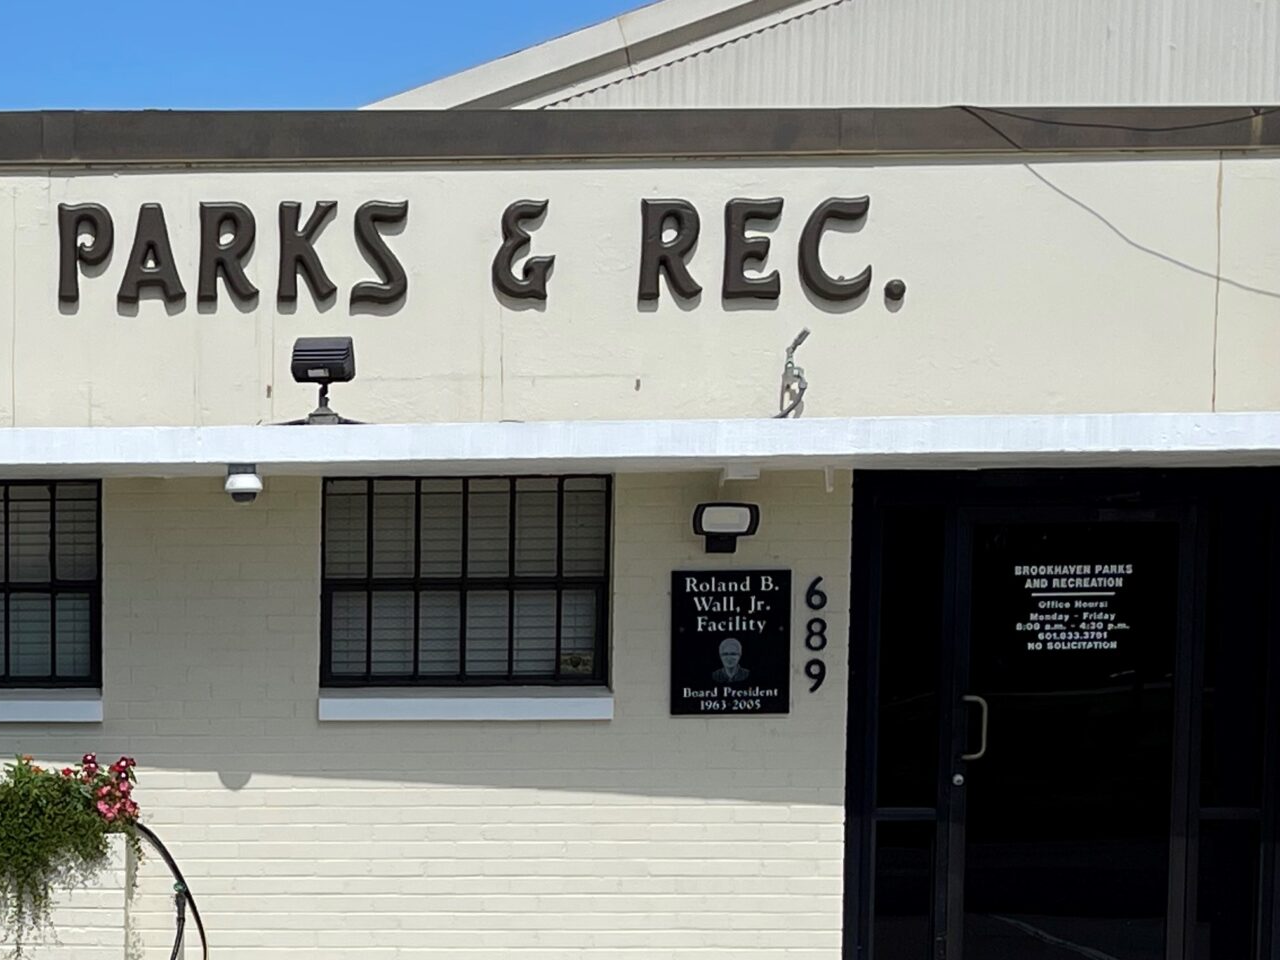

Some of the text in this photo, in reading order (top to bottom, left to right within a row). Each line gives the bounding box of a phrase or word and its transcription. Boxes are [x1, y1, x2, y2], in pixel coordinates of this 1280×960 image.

[56, 199, 409, 310] PARKS
[491, 198, 556, 304] &
[639, 195, 908, 306] REC.
[1014, 564, 1133, 576] BROOKHAVEN PARKS
[685, 576, 779, 592] Roland B.
[1024, 577, 1123, 588] AND RECREATION
[693, 595, 771, 614] Wall, Jr.
[1030, 612, 1070, 622] Monday
[1083, 612, 1116, 621] Friday
[697, 616, 767, 633] Facility
[1027, 641, 1118, 650] NO SOLICITATION
[683, 687, 778, 698] Board President
